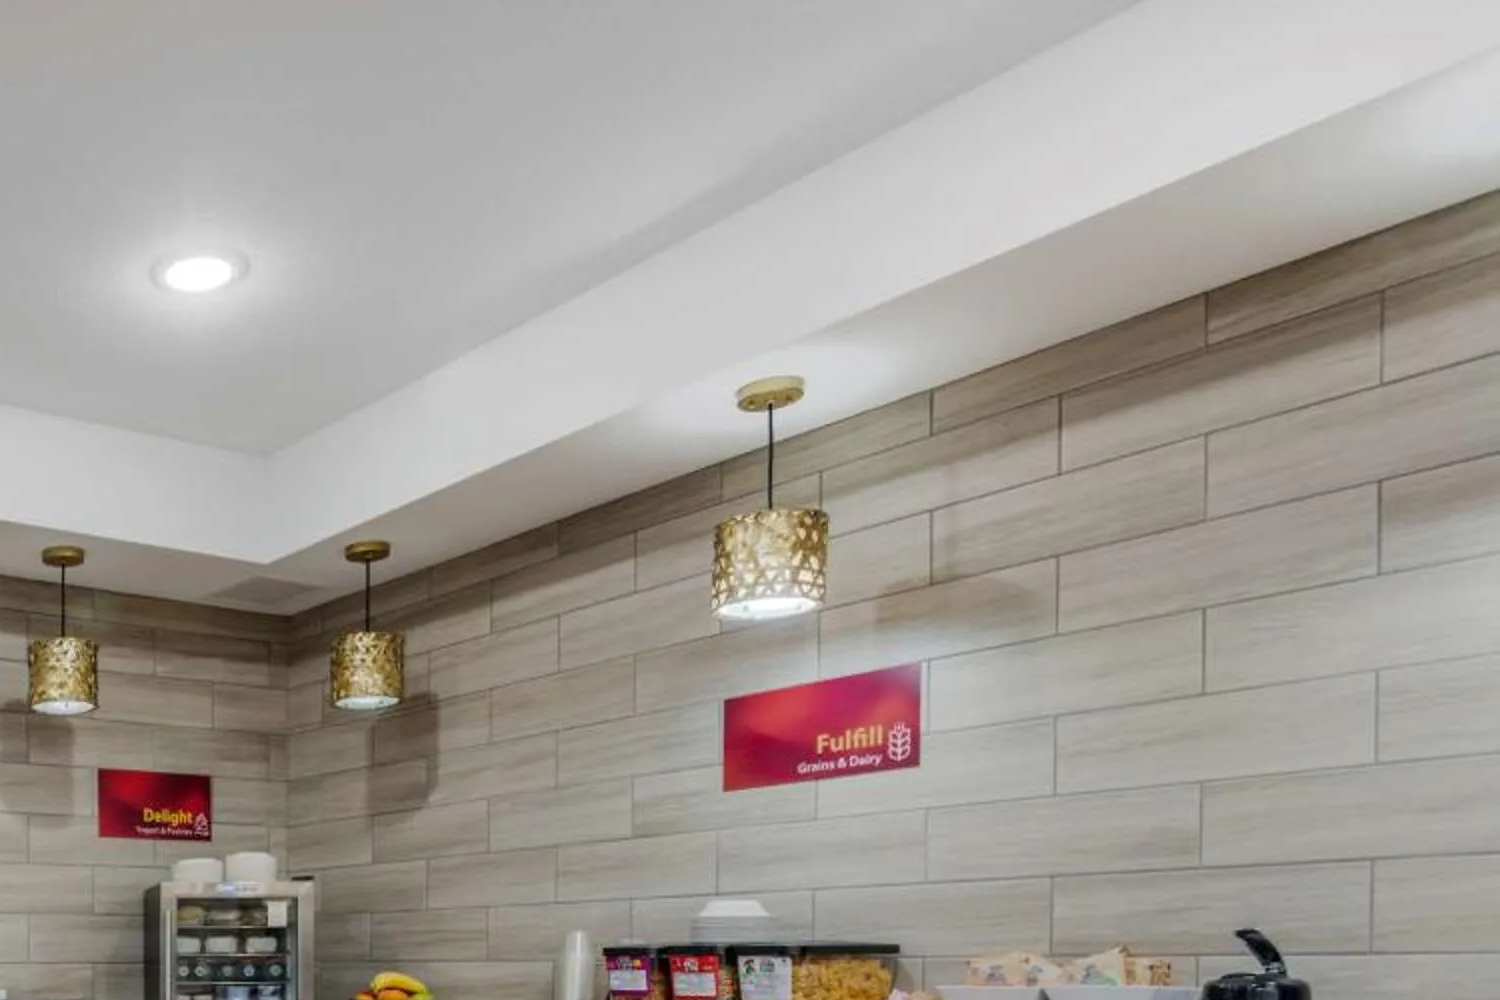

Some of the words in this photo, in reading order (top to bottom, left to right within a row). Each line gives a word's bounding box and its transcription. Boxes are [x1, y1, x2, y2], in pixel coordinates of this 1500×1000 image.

[816, 725, 883, 755] Fulfill
[797, 758, 836, 774] Grains
[837, 756, 848, 769] &
[849, 752, 883, 767] Dairy
[143, 808, 193, 827] Delight
